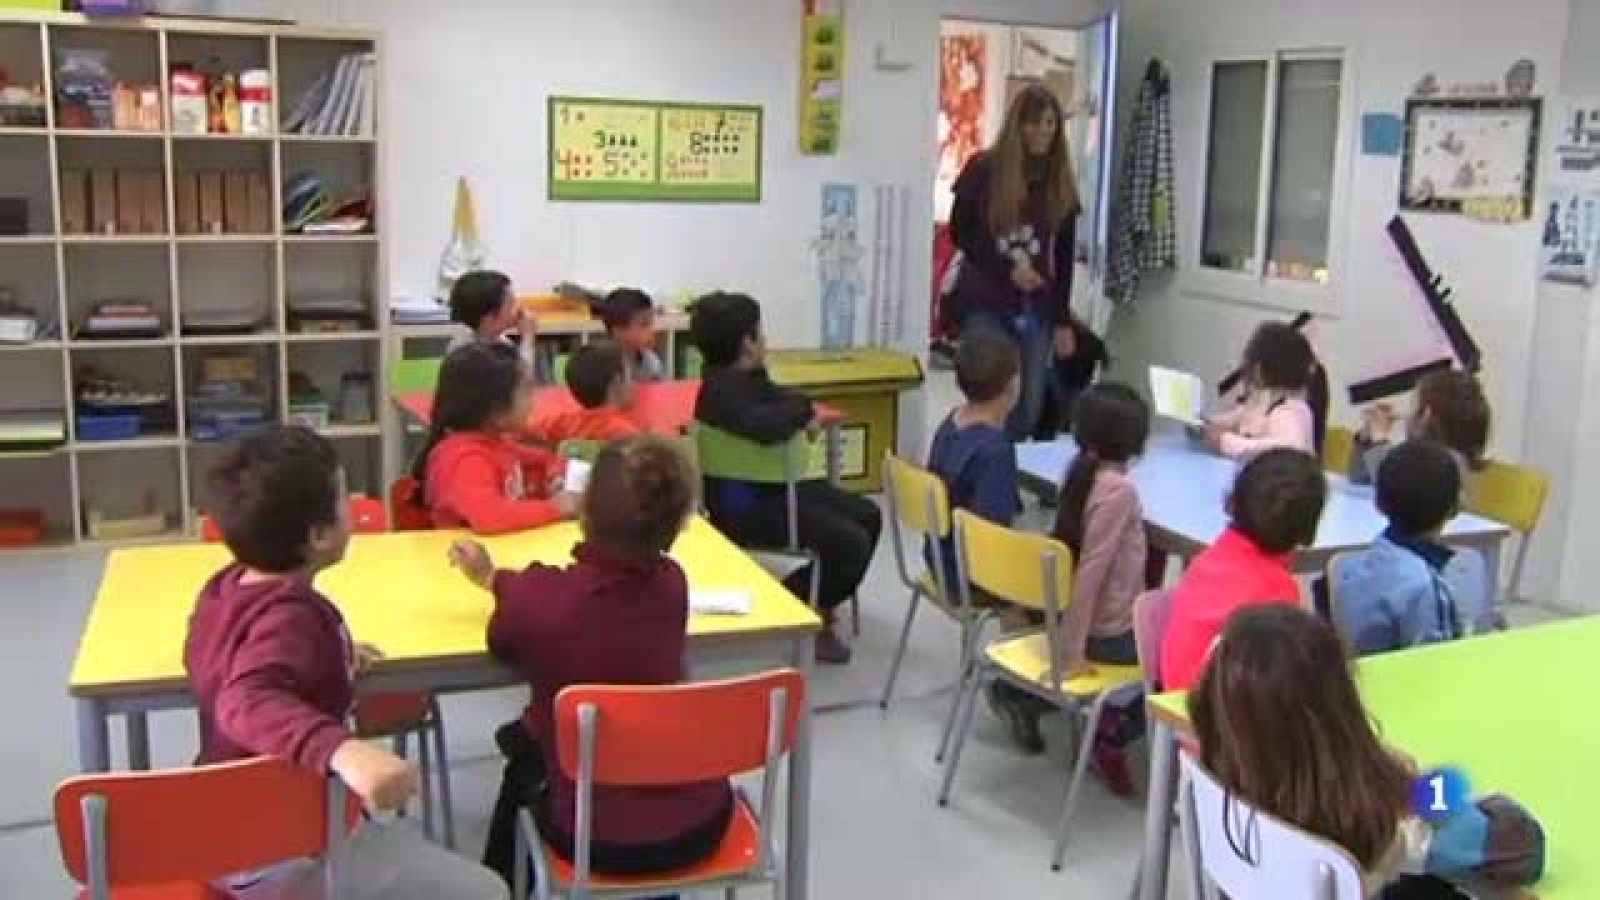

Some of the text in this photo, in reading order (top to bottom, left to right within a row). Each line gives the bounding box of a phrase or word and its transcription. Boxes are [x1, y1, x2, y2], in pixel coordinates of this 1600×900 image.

[594, 130, 606, 150] 3
[555, 149, 571, 180] 4
[604, 151, 618, 177] 5
